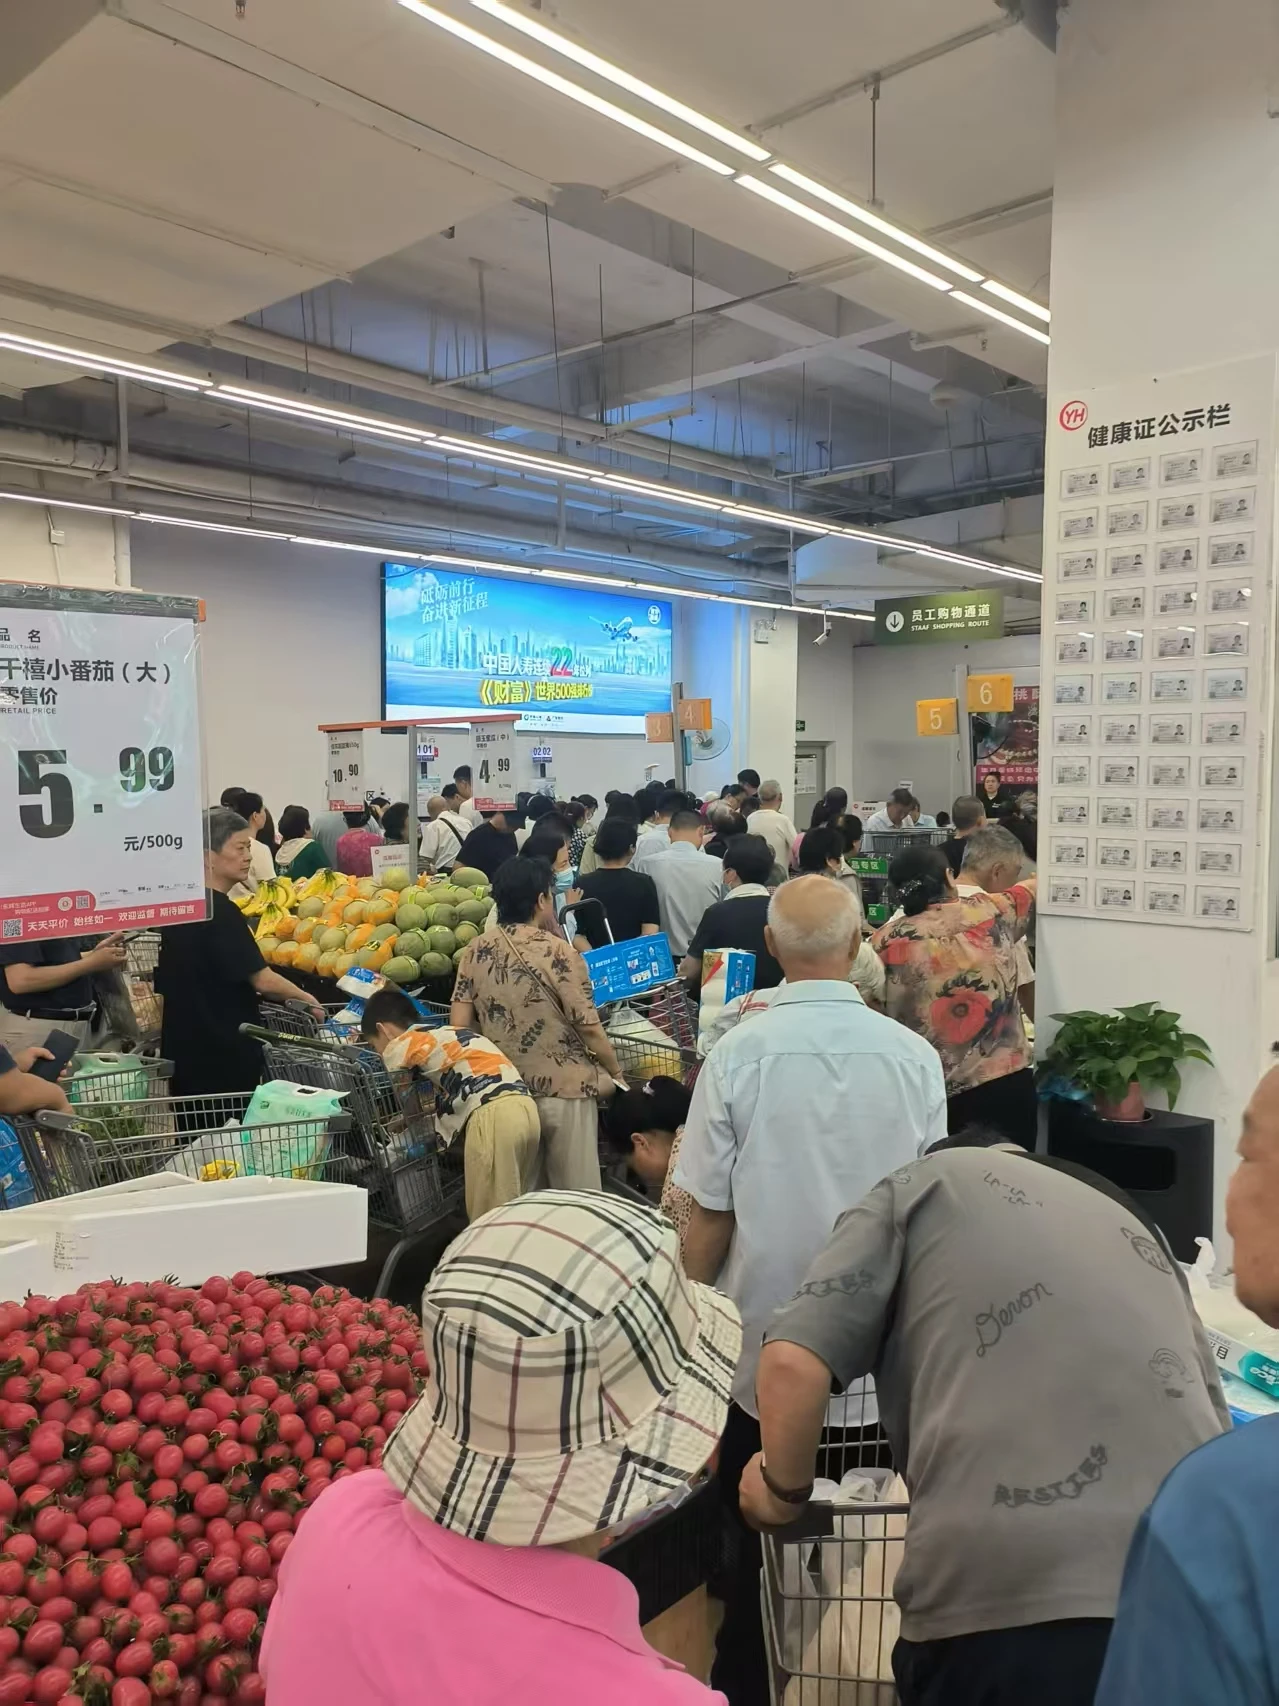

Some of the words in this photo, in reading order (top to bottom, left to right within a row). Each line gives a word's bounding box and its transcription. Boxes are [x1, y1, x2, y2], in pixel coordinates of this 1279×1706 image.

[1088, 403, 1231, 448] 健康证公示栏
[912, 604, 990, 622] 员工购物通道
[933, 621, 965, 630] SHOPPING
[968, 619, 990, 627] ROUTE
[28, 629, 41, 643] 名
[0, 686, 58, 706] 零售价
[481, 679, 532, 705] 《财富》
[979, 682, 993, 705] 6
[33, 707, 57, 715] PRICE
[684, 703, 695, 725] 4
[929, 708, 942, 730] 5
[543, 746, 551, 755] 02
[333, 763, 359, 783] 10.90
[479, 757, 510, 784] 4.99
[18, 745, 175, 839] 5.99
[124, 833, 183, 852] 元/500g
[28, 917, 68, 932] 天天平价
[73, 912, 113, 927] 始终如一
[118, 908, 155, 922] 欢迎监督
[160, 904, 195, 917] 期待留言
